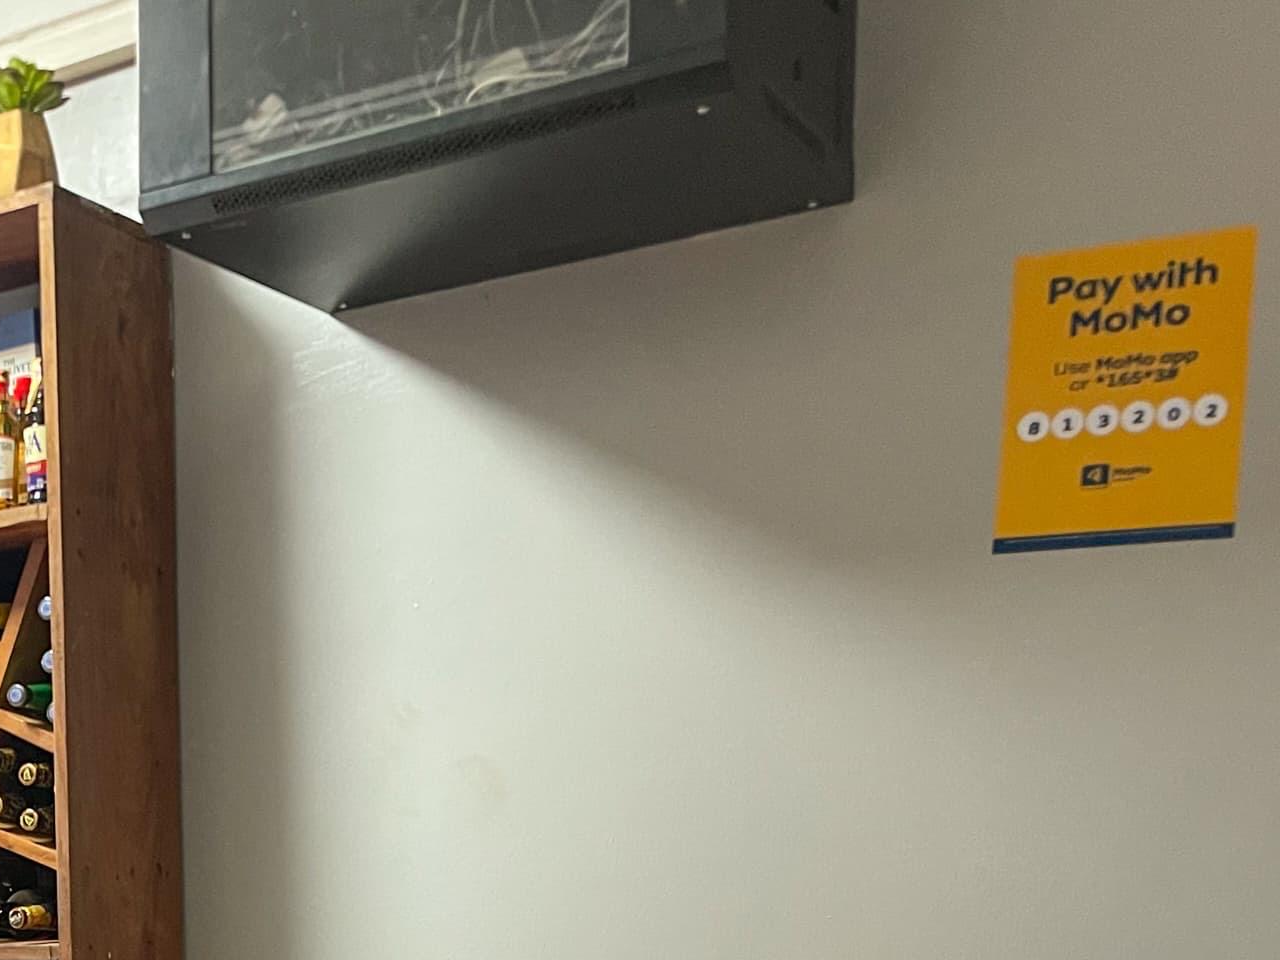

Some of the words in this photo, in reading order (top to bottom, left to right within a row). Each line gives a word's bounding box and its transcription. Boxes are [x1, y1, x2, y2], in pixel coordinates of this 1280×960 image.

[1048, 276, 1123, 305] Pay
[1133, 257, 1219, 293] with
[1070, 301, 1191, 338] MoMo
[1054, 361, 1091, 376] Use
[1095, 353, 1156, 371] MoMo
[1160, 350, 1199, 366] app
[1069, 379, 1090, 391] or
